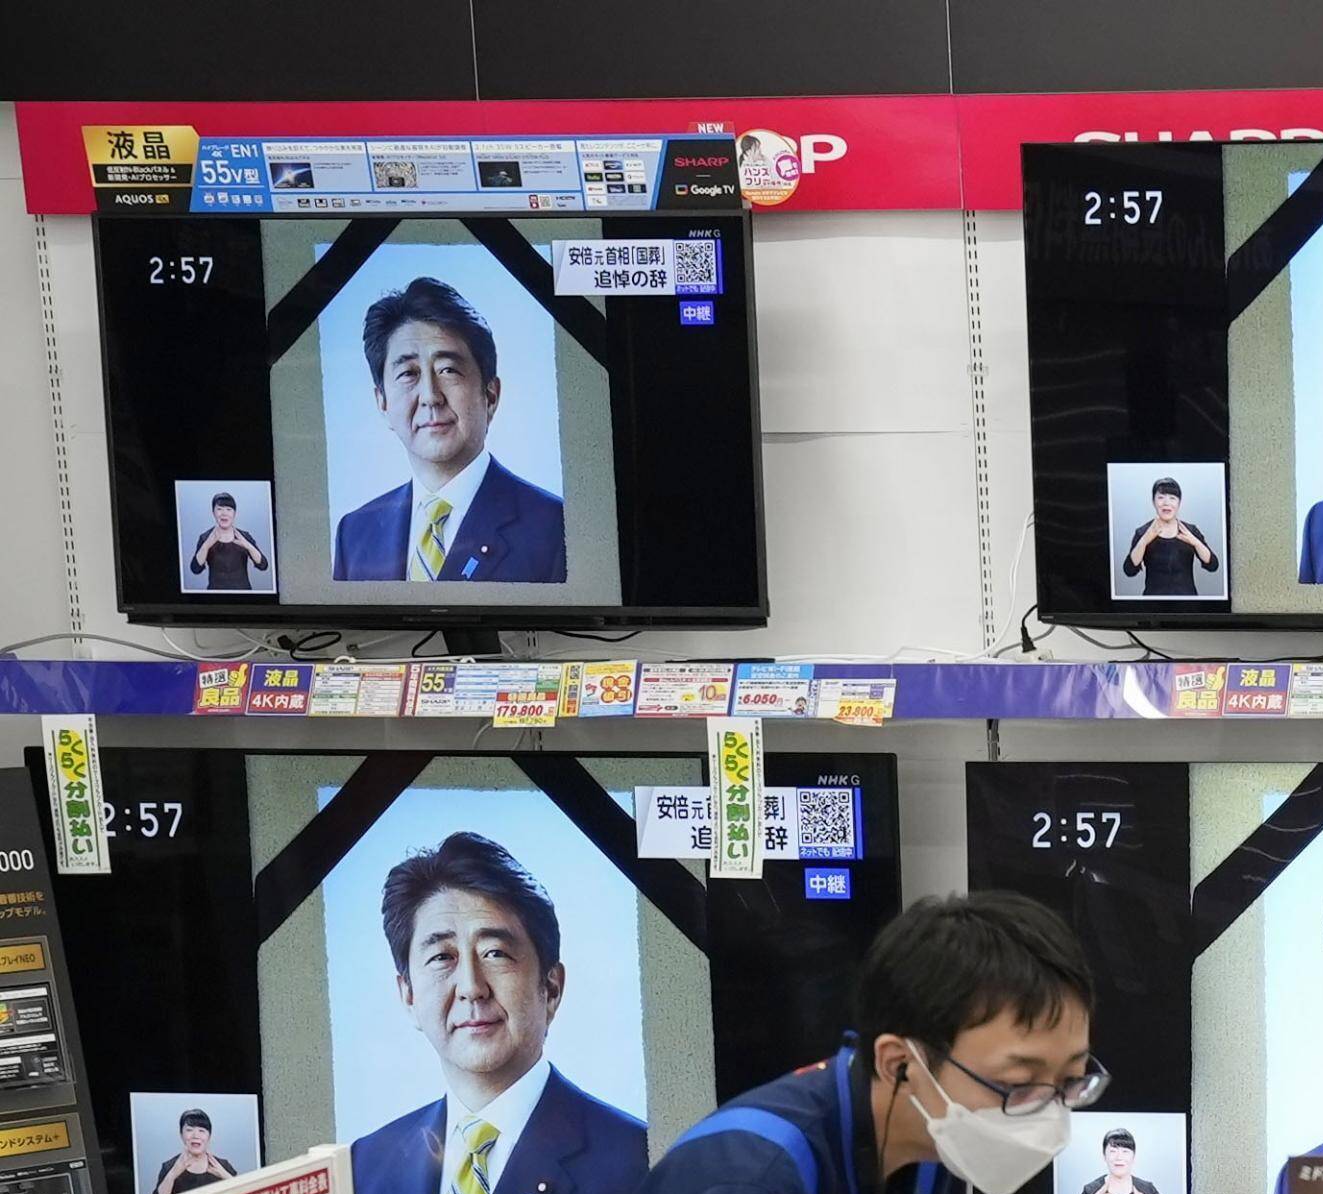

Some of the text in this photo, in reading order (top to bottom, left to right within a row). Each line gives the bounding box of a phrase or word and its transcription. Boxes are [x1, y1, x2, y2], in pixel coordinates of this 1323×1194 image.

[698, 124, 725, 133] NEW
[107, 131, 170, 160] 液晶
[231, 142, 260, 158] EN1
[674, 157, 730, 168] SHARP
[201, 161, 260, 185] 55V型
[115, 194, 154, 204] AQUOS
[690, 185, 734, 197] Google TV
[1084, 191, 1163, 225] 2:57
[568, 246, 665, 269] 安倍元首相「国葬」
[149, 257, 214, 284] 2:57
[594, 271, 667, 289] 追悼の辞
[683, 306, 711, 322] 中継
[264, 669, 299, 687] 液晶
[1241, 669, 1275, 686] 液晶
[200, 688, 240, 706] 良品
[252, 693, 304, 710] 4K内蔵
[1228, 695, 1282, 709] 4K内蔵
[817, 775, 861, 785] NHK G
[103, 803, 182, 837] 2:57
[1032, 812, 1122, 849] 2:57
[809, 875, 846, 893] 中継
